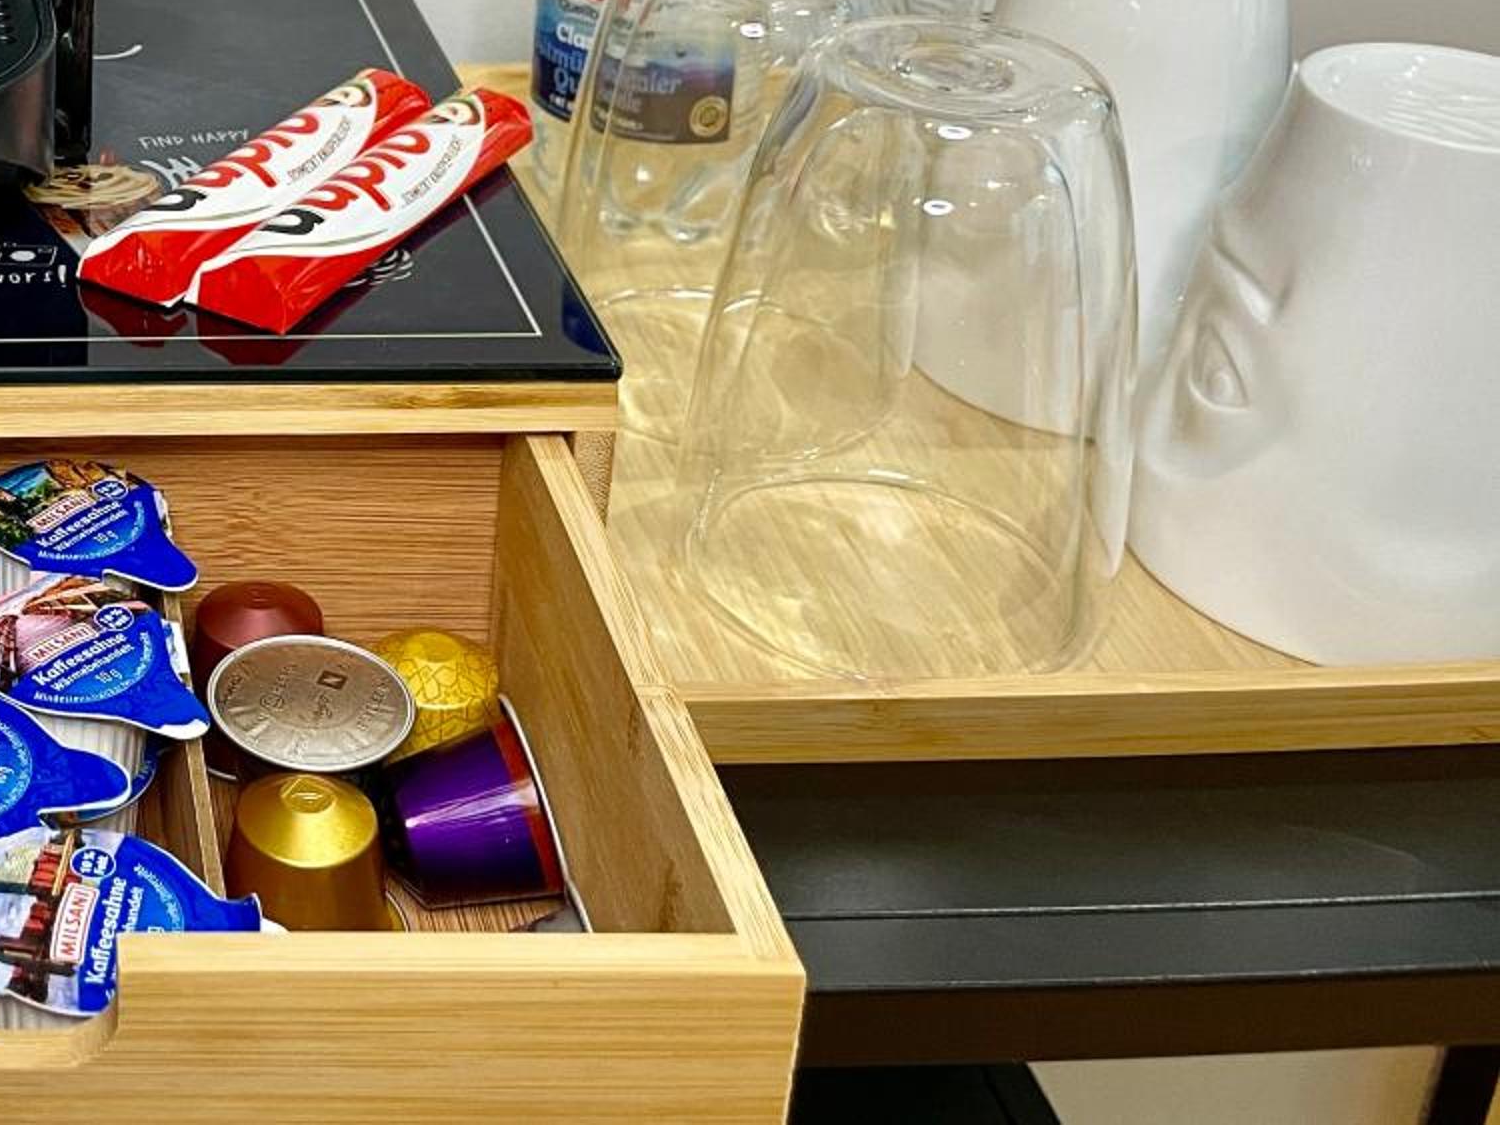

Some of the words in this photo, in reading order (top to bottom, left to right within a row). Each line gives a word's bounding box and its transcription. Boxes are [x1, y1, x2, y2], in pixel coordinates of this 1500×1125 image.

[137, 135, 185, 151] FIND
[190, 129, 250, 146] HAPPY
[35, 501, 121, 548] Kaffeesahne
[31, 625, 92, 660] MILSANI
[31, 632, 127, 687] Kaffeesahne
[50, 643, 136, 692] Wärmebehandelt
[60, 889, 89, 956] MILSANI
[84, 876, 128, 984] Kaffeesahne
